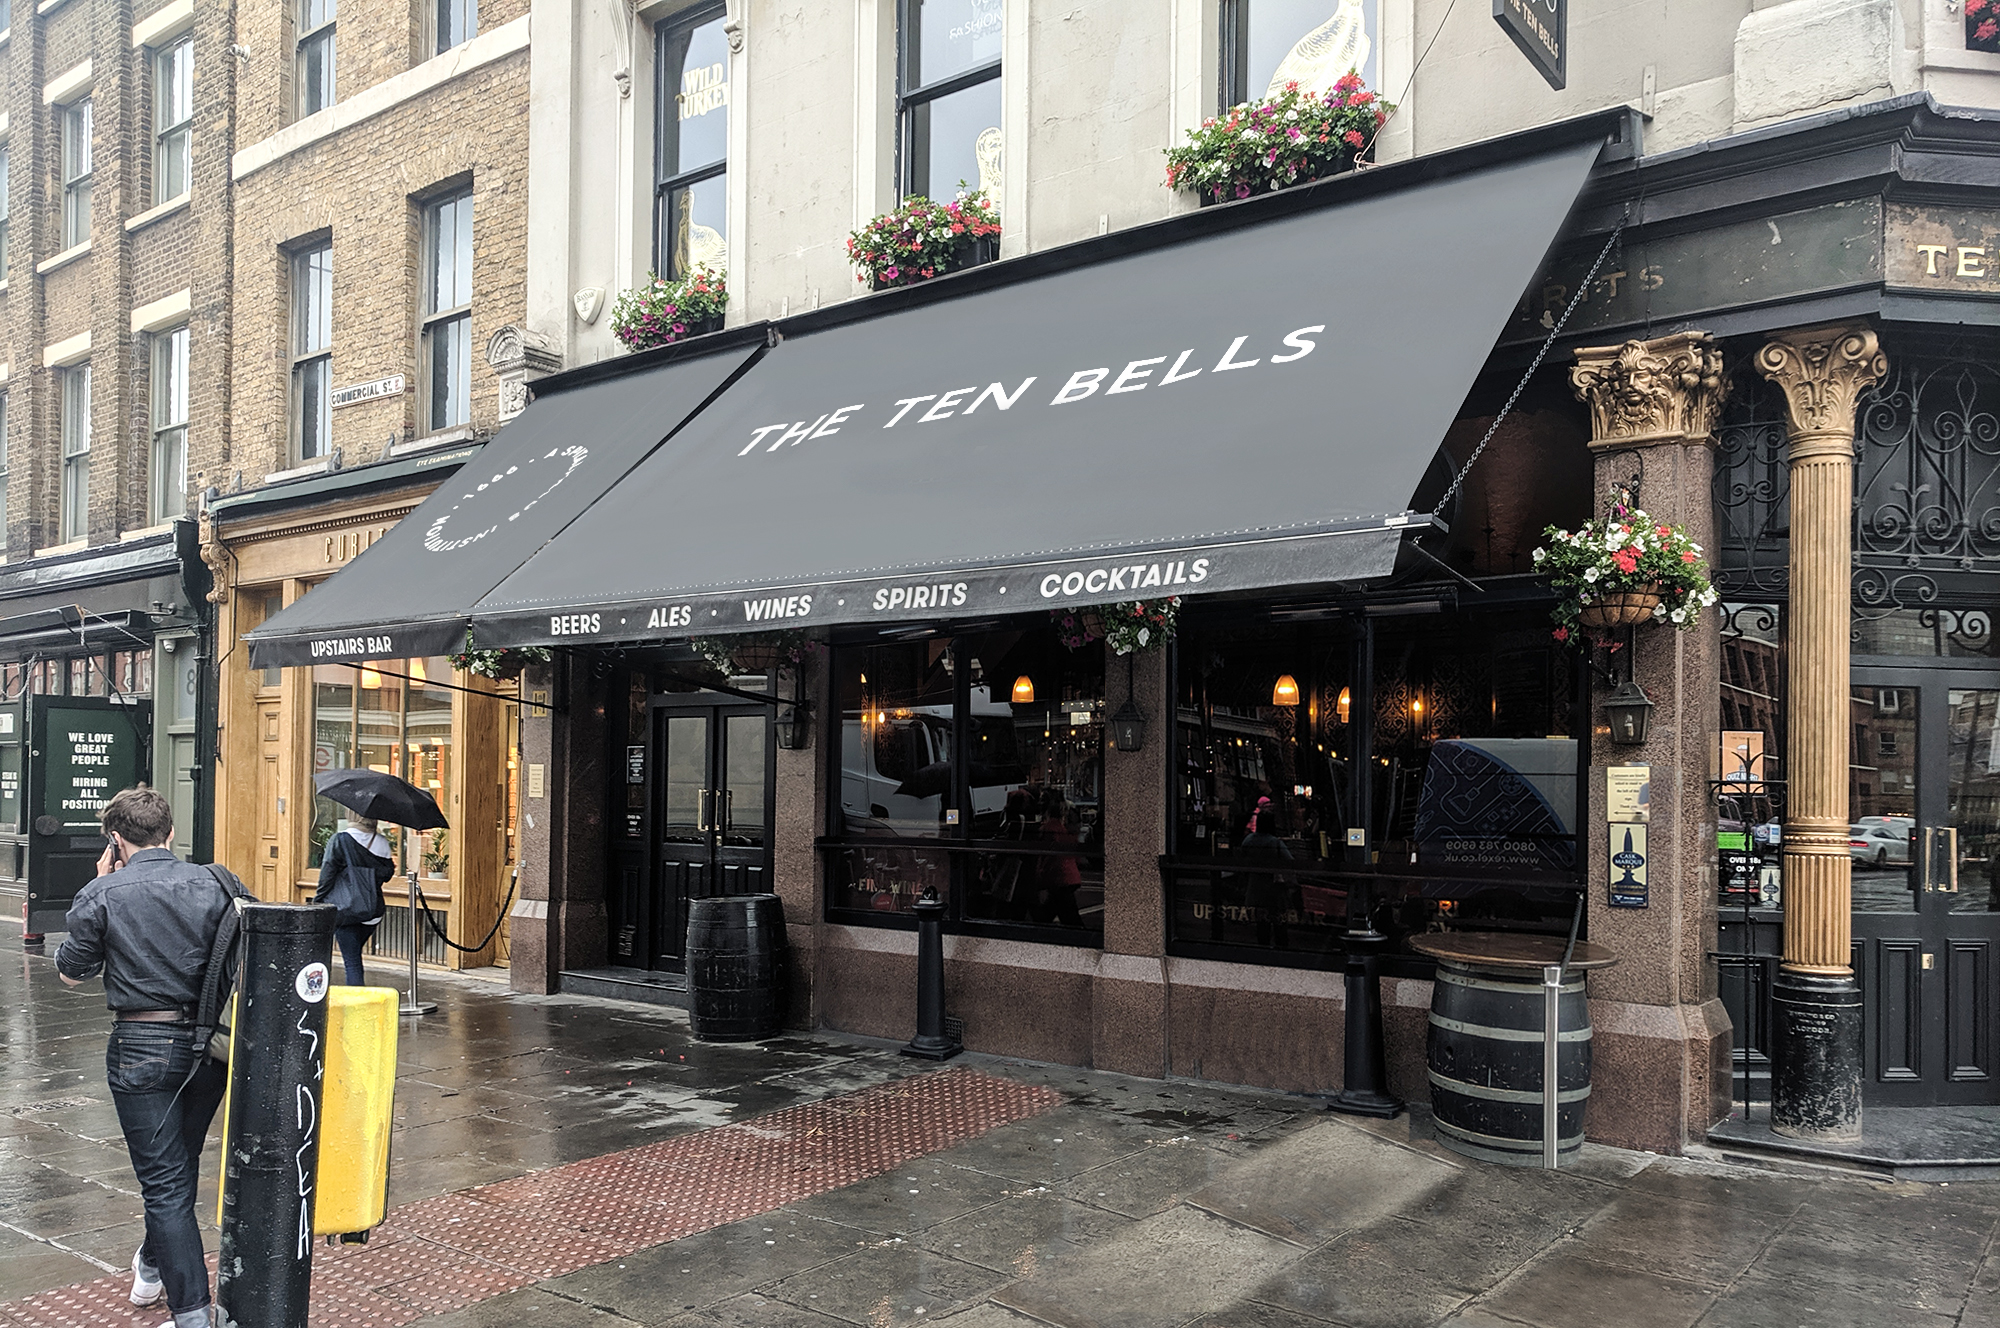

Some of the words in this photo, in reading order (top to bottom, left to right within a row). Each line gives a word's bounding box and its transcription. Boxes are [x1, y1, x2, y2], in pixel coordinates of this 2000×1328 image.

[1522, 2, 1538, 34] TEN
[1538, 22, 1559, 60] BELLS
[684, 62, 723, 96] WILD
[674, 82, 727, 121] TURKEY
[1916, 244, 2000, 278] TE
[331, 384, 380, 405] COMMERCIAL
[737, 403, 865, 457] THE
[882, 376, 1038, 429] TEN
[1049, 324, 1326, 406] BELLS
[551, 614, 601, 636] BEERS
[647, 604, 692, 629] ALES
[743, 595, 813, 622] WINES
[872, 582, 968, 612] SPIRITS
[1039, 558, 1210, 599] COCKTAILS
[311, 636, 365, 657] UPSTAIRS
[367, 635, 393, 654] BAR
[187, 669, 196, 696] 8
[68, 732, 85, 742] WE
[88, 733, 114, 743] LOVE
[74, 744, 108, 754] GREAT
[71, 755, 110, 765] PEOPLE
[72, 777, 108, 787] HIRING
[80, 788, 100, 798] ALL
